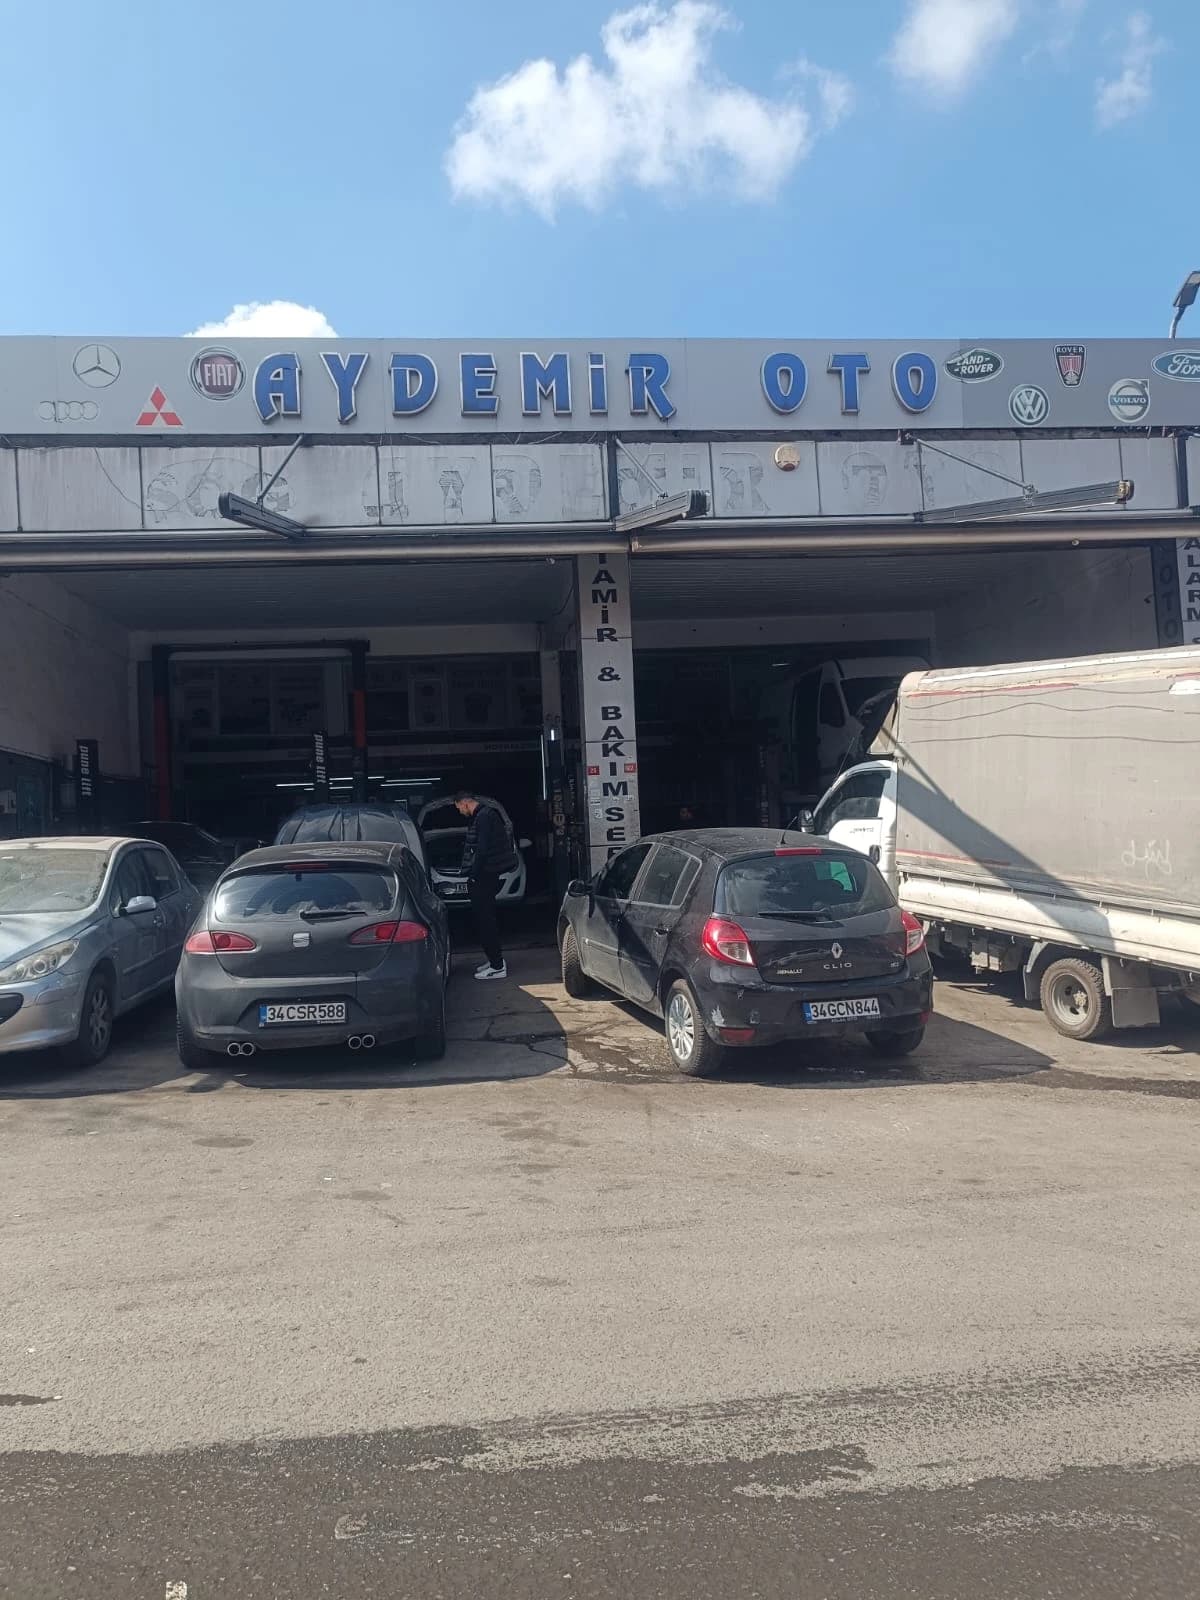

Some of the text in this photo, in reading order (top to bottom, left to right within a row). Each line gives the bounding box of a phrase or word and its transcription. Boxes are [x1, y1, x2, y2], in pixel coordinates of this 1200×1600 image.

[1167, 353, 1200, 375] For
[203, 363, 235, 386] FIAT
[252, 351, 939, 424] AYDEMİR OTO
[1112, 396, 1147, 404] VOLVO
[597, 666, 621, 682] &
[823, 962, 853, 970] CLIO
